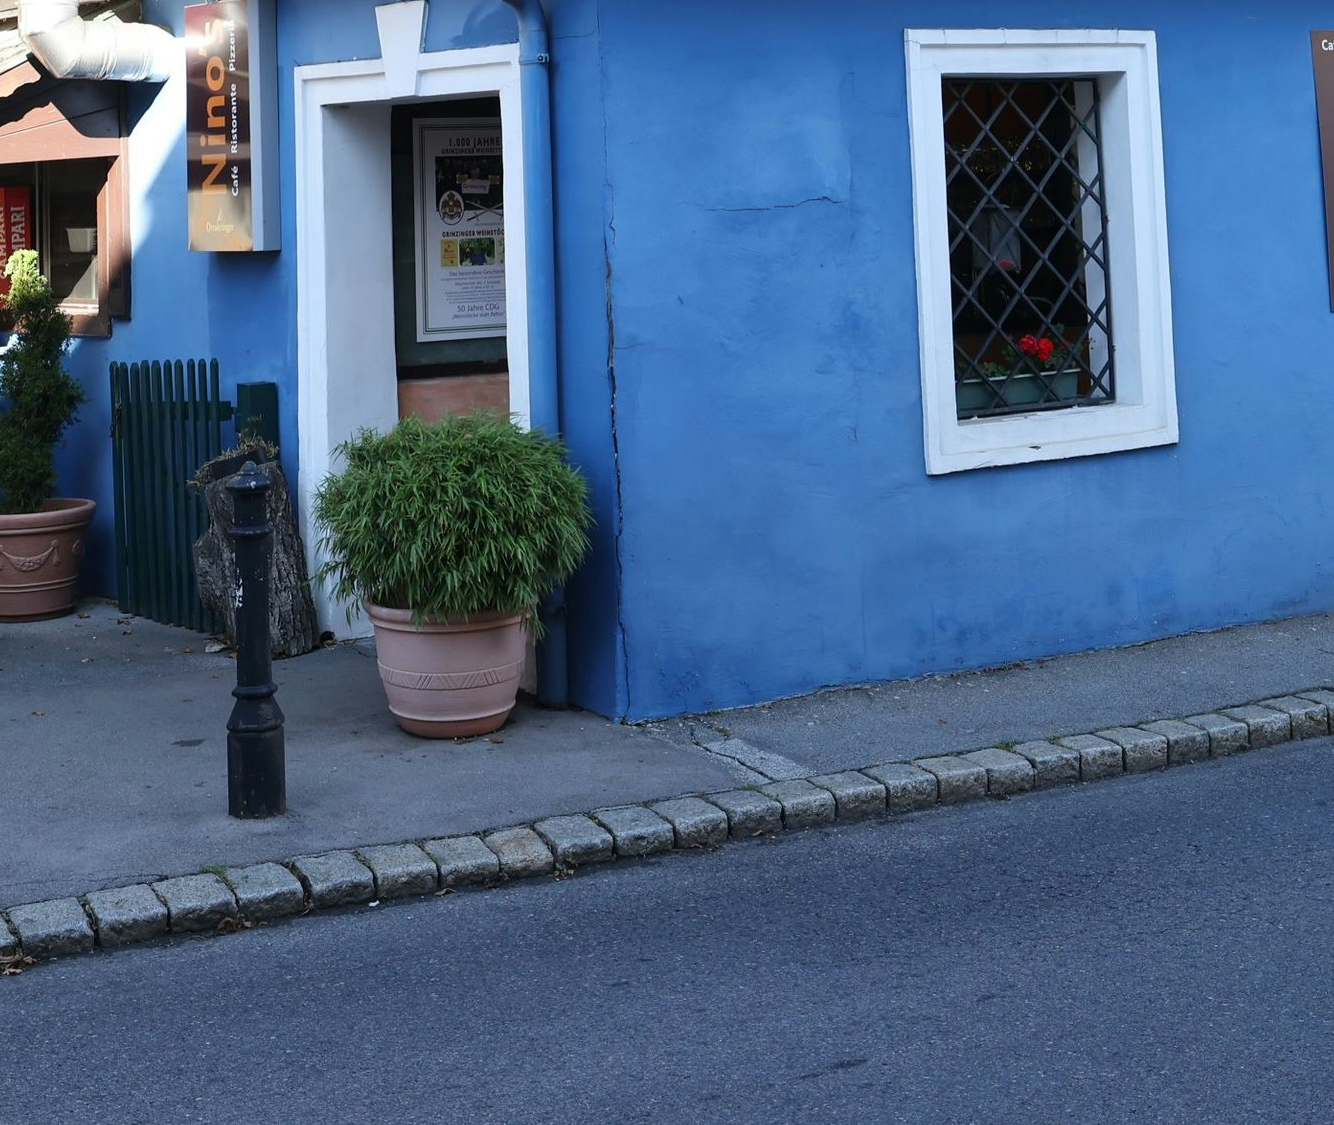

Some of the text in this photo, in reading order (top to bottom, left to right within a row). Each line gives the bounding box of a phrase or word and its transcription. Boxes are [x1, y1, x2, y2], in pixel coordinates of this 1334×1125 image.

[230, 83, 238, 154] Ristorante
[449, 136, 500, 148] 1.000 JAHRE
[231, 166, 239, 197] Café
[442, 230, 475, 238] GRINZINGER
[467, 304, 484, 312] Jahre
[485, 302, 500, 311] CDG
